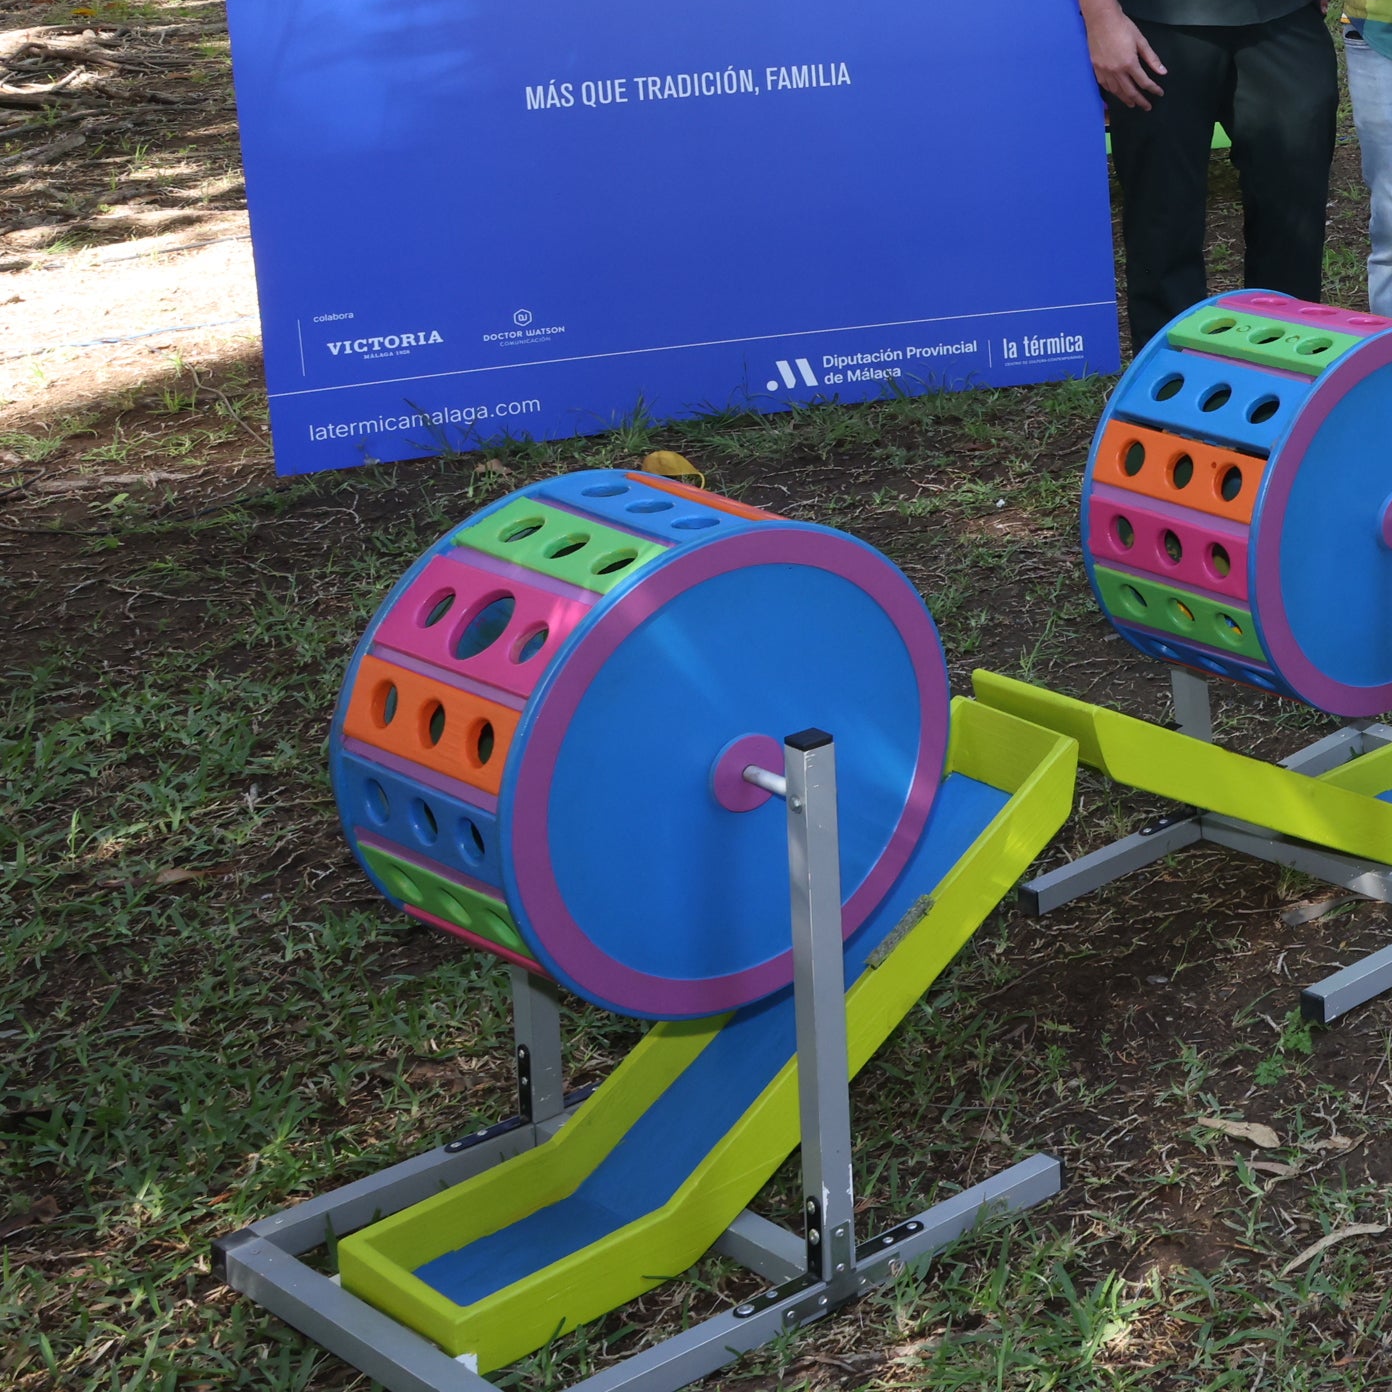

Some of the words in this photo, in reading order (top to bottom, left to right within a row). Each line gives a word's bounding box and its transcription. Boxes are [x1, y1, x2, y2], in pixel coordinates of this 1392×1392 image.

[525, 79, 575, 110] MÁS
[581, 78, 628, 108] QUE
[634, 65, 760, 101] TRADICIÓN,
[766, 62, 851, 90] FAMILIA
[313, 312, 354, 323] colabora
[327, 330, 444, 356] VICTORIA
[483, 330, 522, 342] DOCTOR
[525, 326, 565, 337] WATSON
[1003, 338, 1018, 359] la
[1023, 332, 1084, 357] térmica
[823, 348, 902, 370] Diputación
[907, 340, 977, 359] Provincial
[824, 372, 843, 385] de
[847, 367, 902, 382] Málaga
[309, 399, 541, 441] latermicamalaga.com
